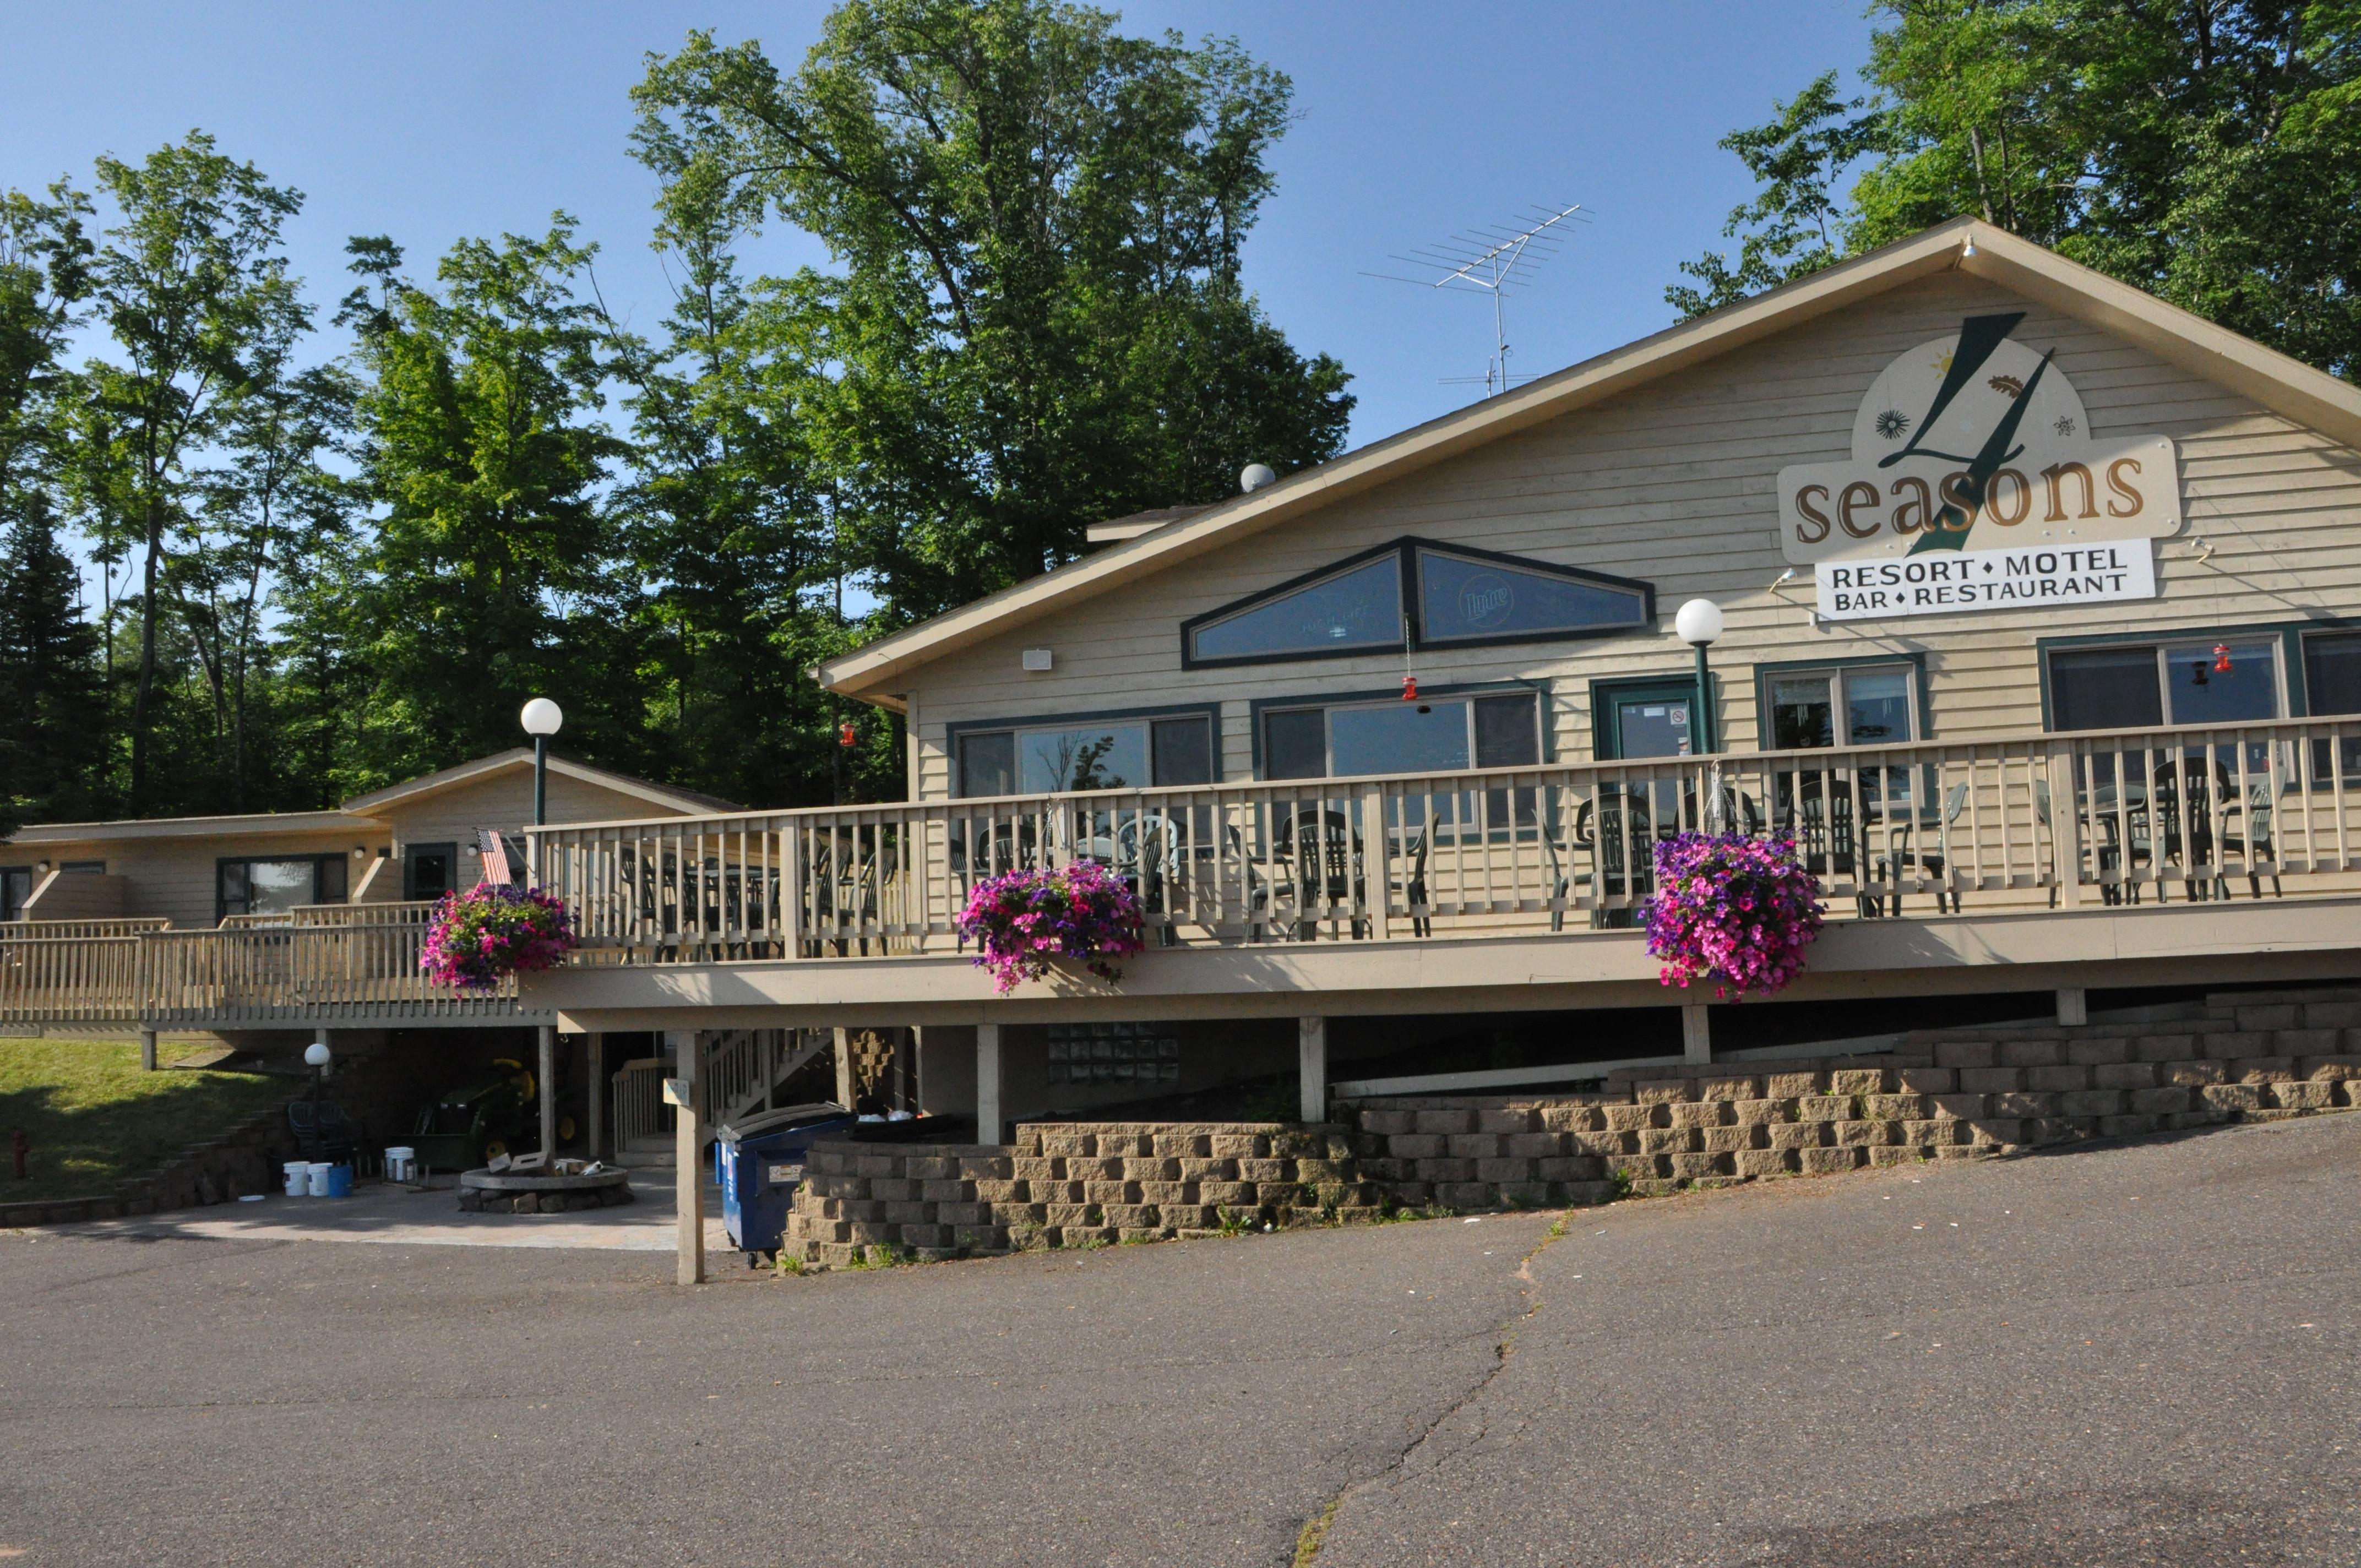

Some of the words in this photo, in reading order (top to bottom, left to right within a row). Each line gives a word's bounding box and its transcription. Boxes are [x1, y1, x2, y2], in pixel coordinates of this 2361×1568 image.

[1795, 457, 2144, 545] seasons
[1832, 559, 1976, 589] RESORT
[2006, 549, 2128, 577] MOTEL
[1835, 591, 1888, 611] BAR
[1914, 574, 2128, 606] RESTAURANT
